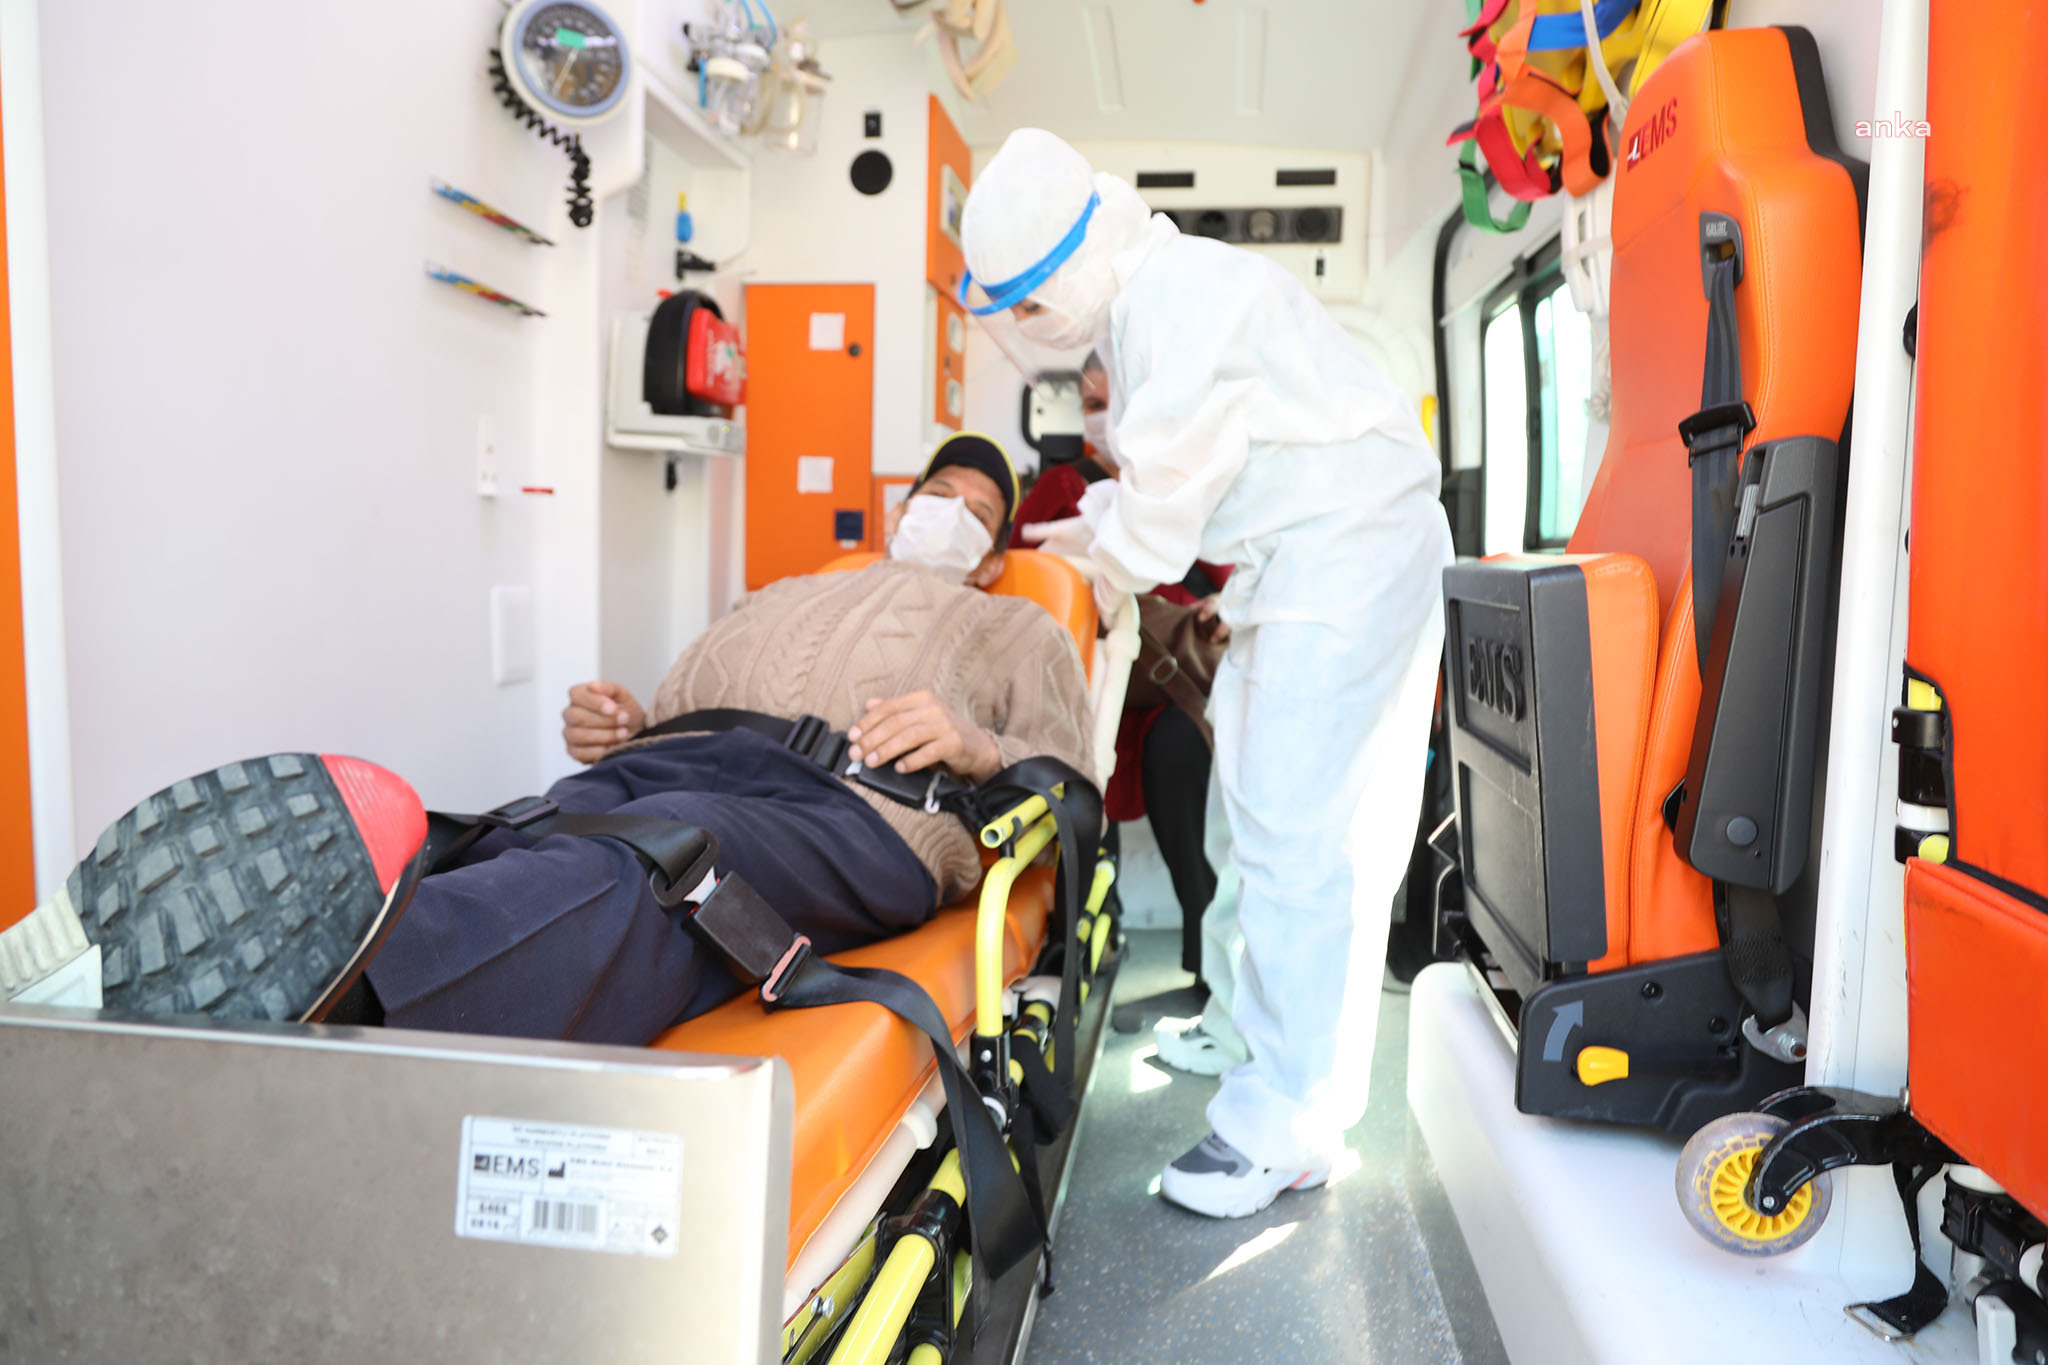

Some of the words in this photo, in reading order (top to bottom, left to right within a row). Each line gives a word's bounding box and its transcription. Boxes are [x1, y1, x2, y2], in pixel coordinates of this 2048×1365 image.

[1640, 97, 1678, 161] EMS
[1468, 637, 1527, 724] EMS
[493, 1154, 541, 1178] EMS
